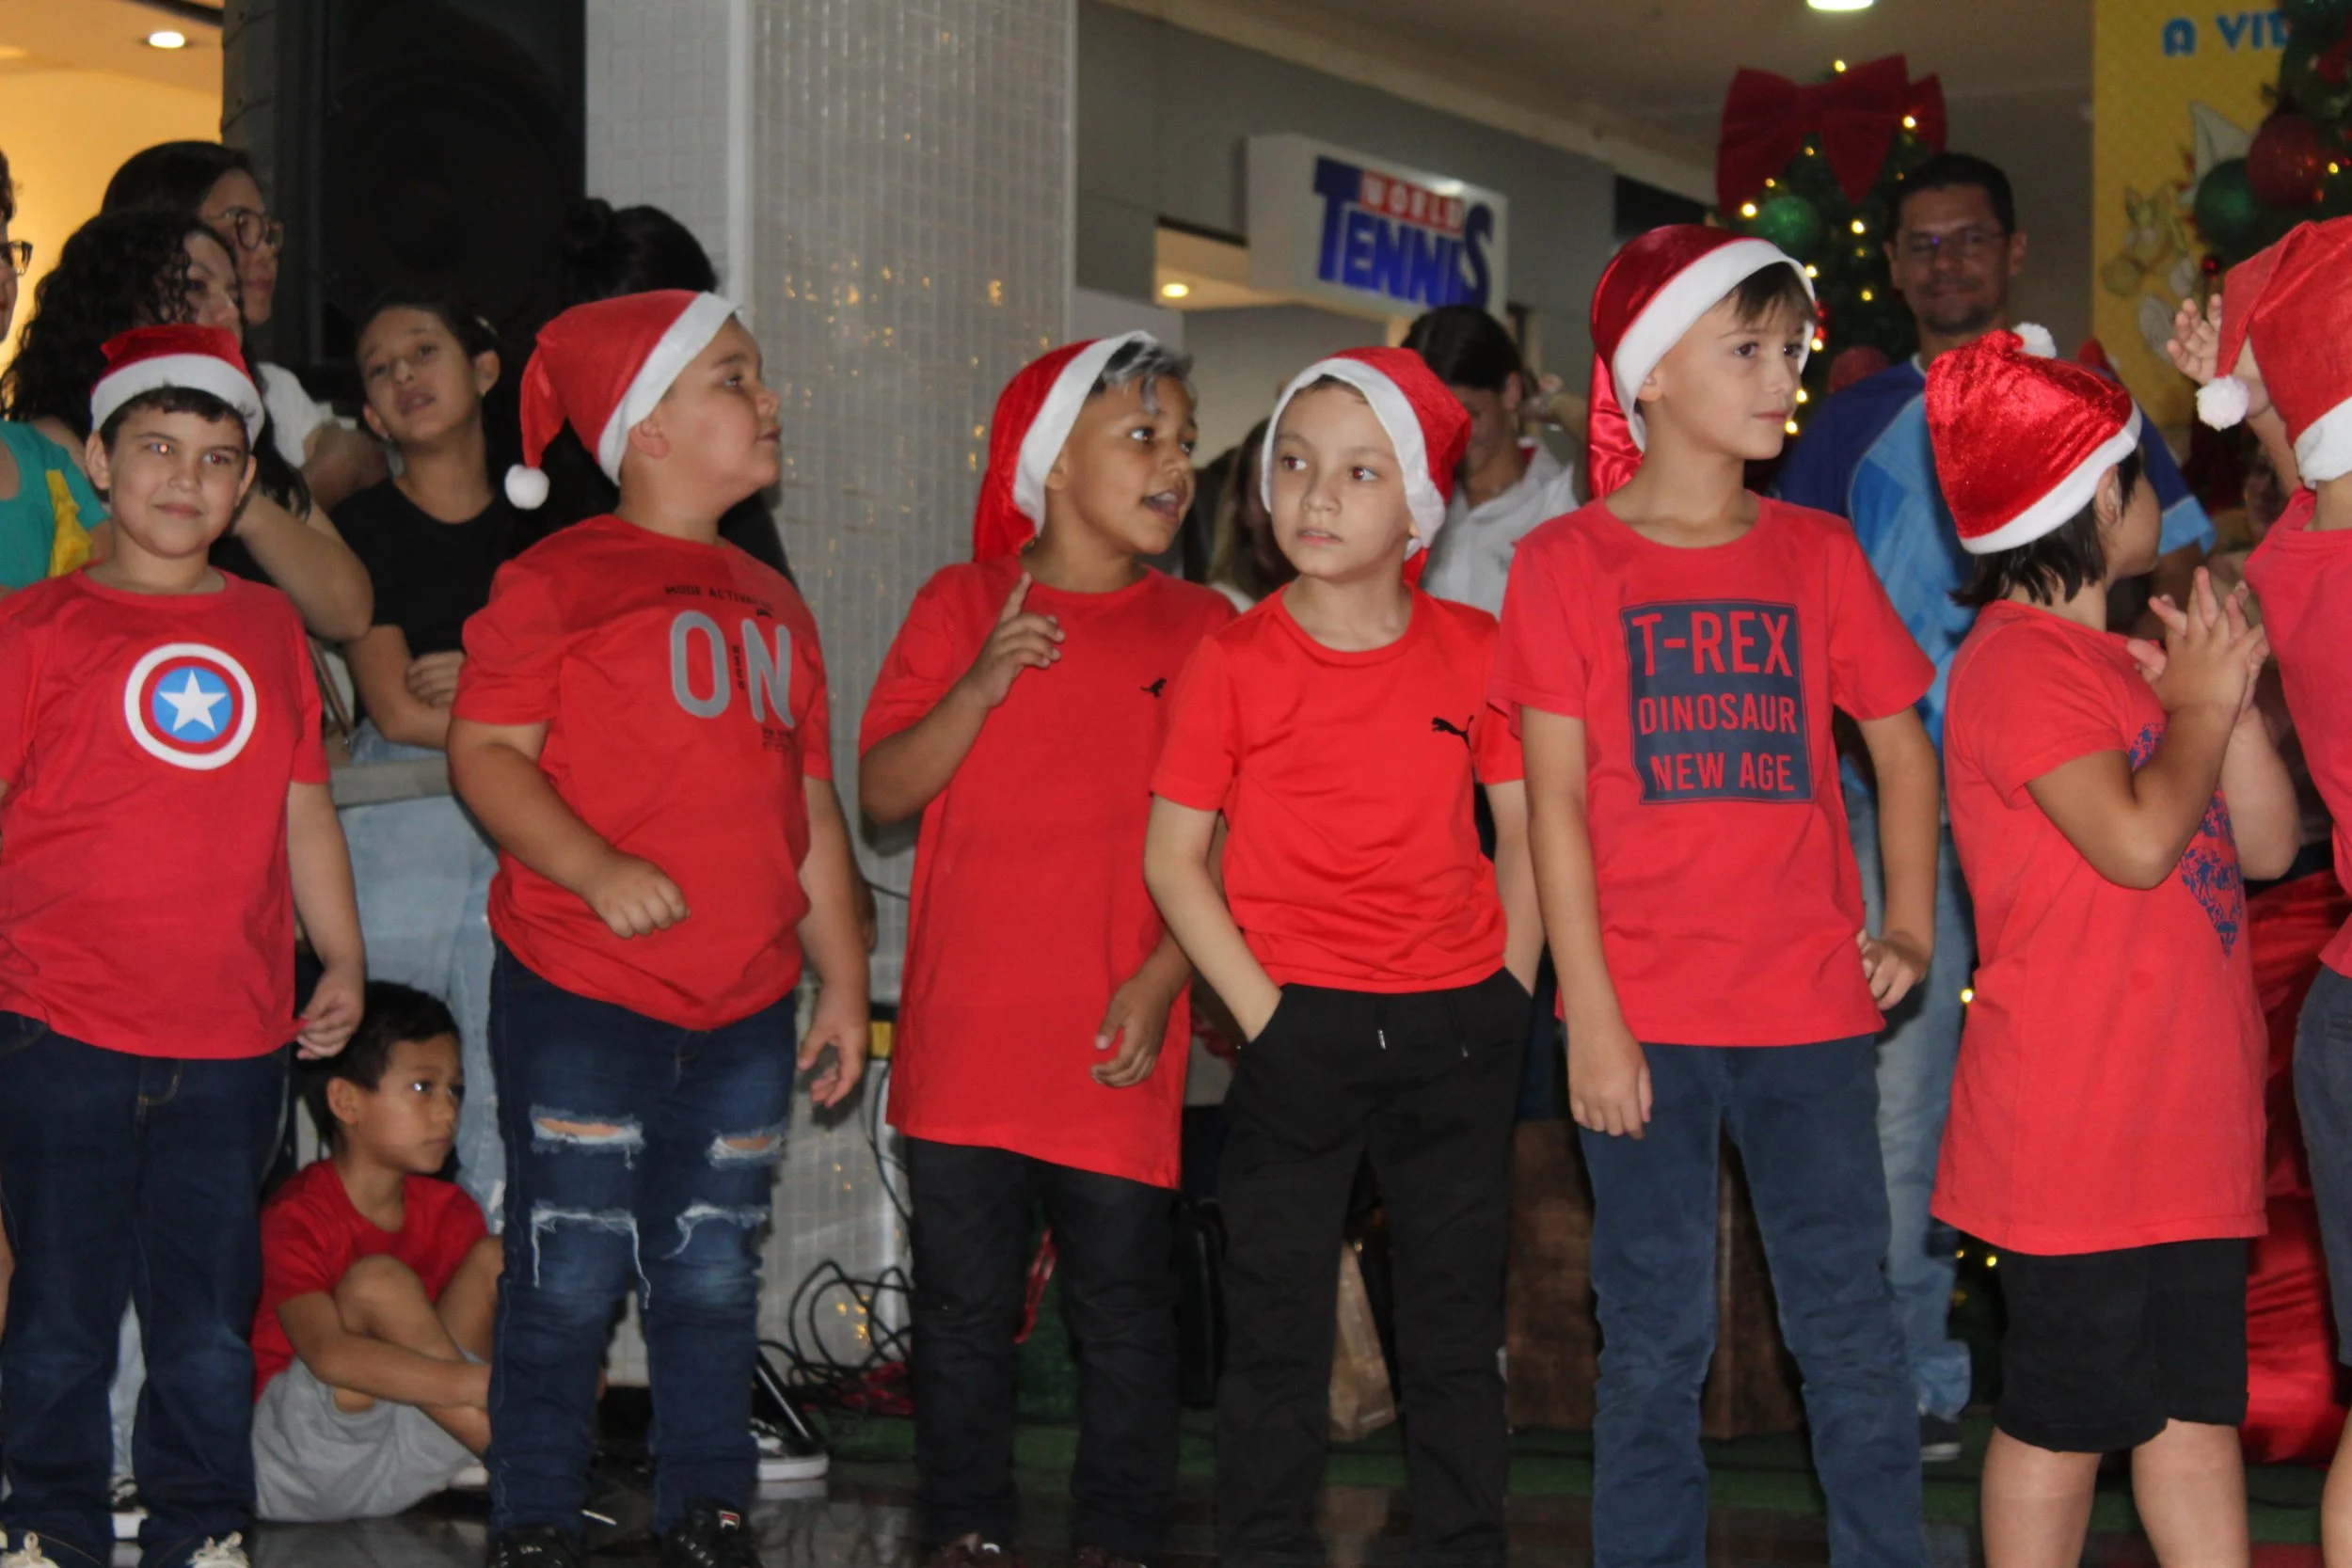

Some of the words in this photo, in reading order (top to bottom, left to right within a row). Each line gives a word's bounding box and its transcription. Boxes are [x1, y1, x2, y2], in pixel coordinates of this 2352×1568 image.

[1313, 155, 1494, 310] TENNIS
[1361, 173, 1464, 230] WORLD
[669, 609, 796, 728] ON
[1631, 610, 1793, 677] T-REX
[1638, 692, 1797, 736] DINOSAUR
[1651, 752, 1724, 791] NEW
[1739, 752, 1795, 792] AGE
